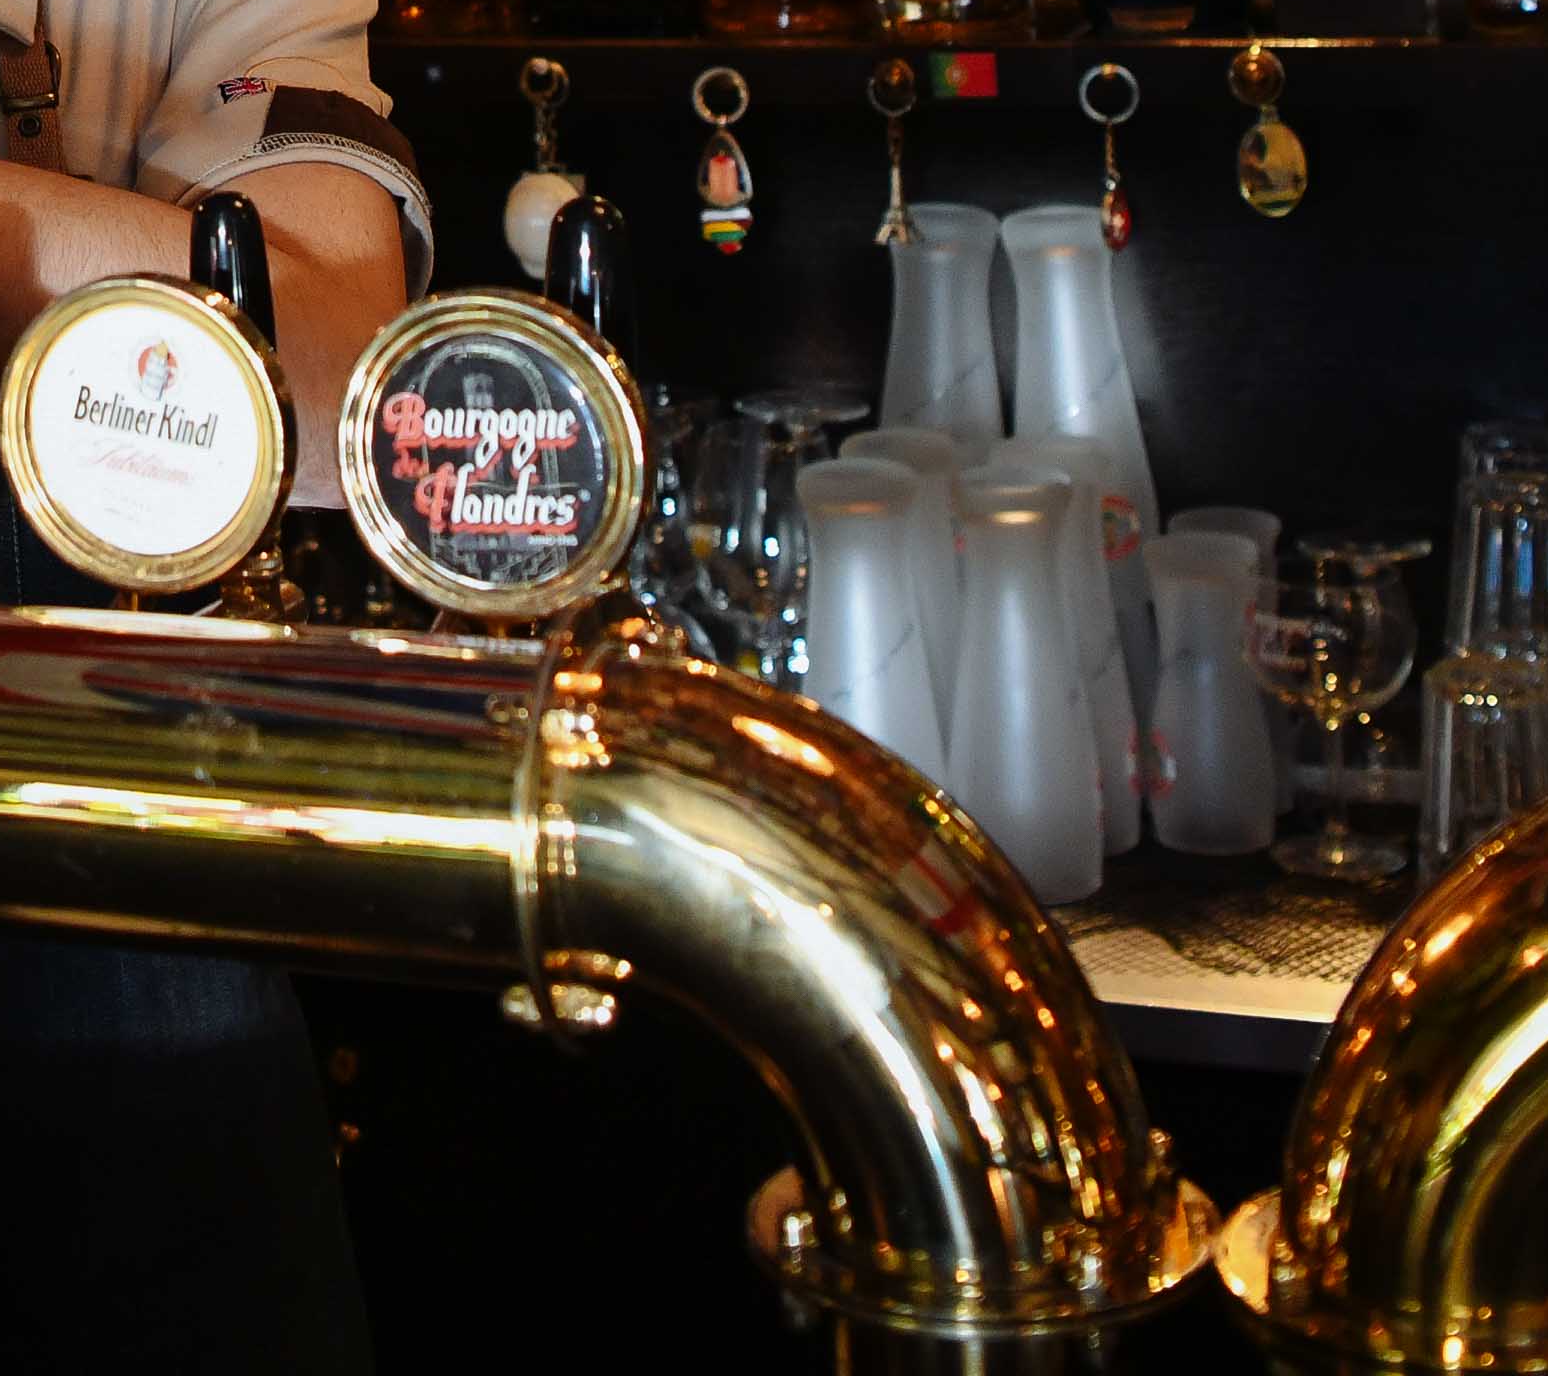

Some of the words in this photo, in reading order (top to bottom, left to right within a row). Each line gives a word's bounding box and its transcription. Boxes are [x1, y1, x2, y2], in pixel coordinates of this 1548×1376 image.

[72, 384, 156, 439] Berliner
[158, 404, 221, 451] Kindl
[383, 391, 579, 468] Bourgogne
[413, 464, 579, 533] Flandres
